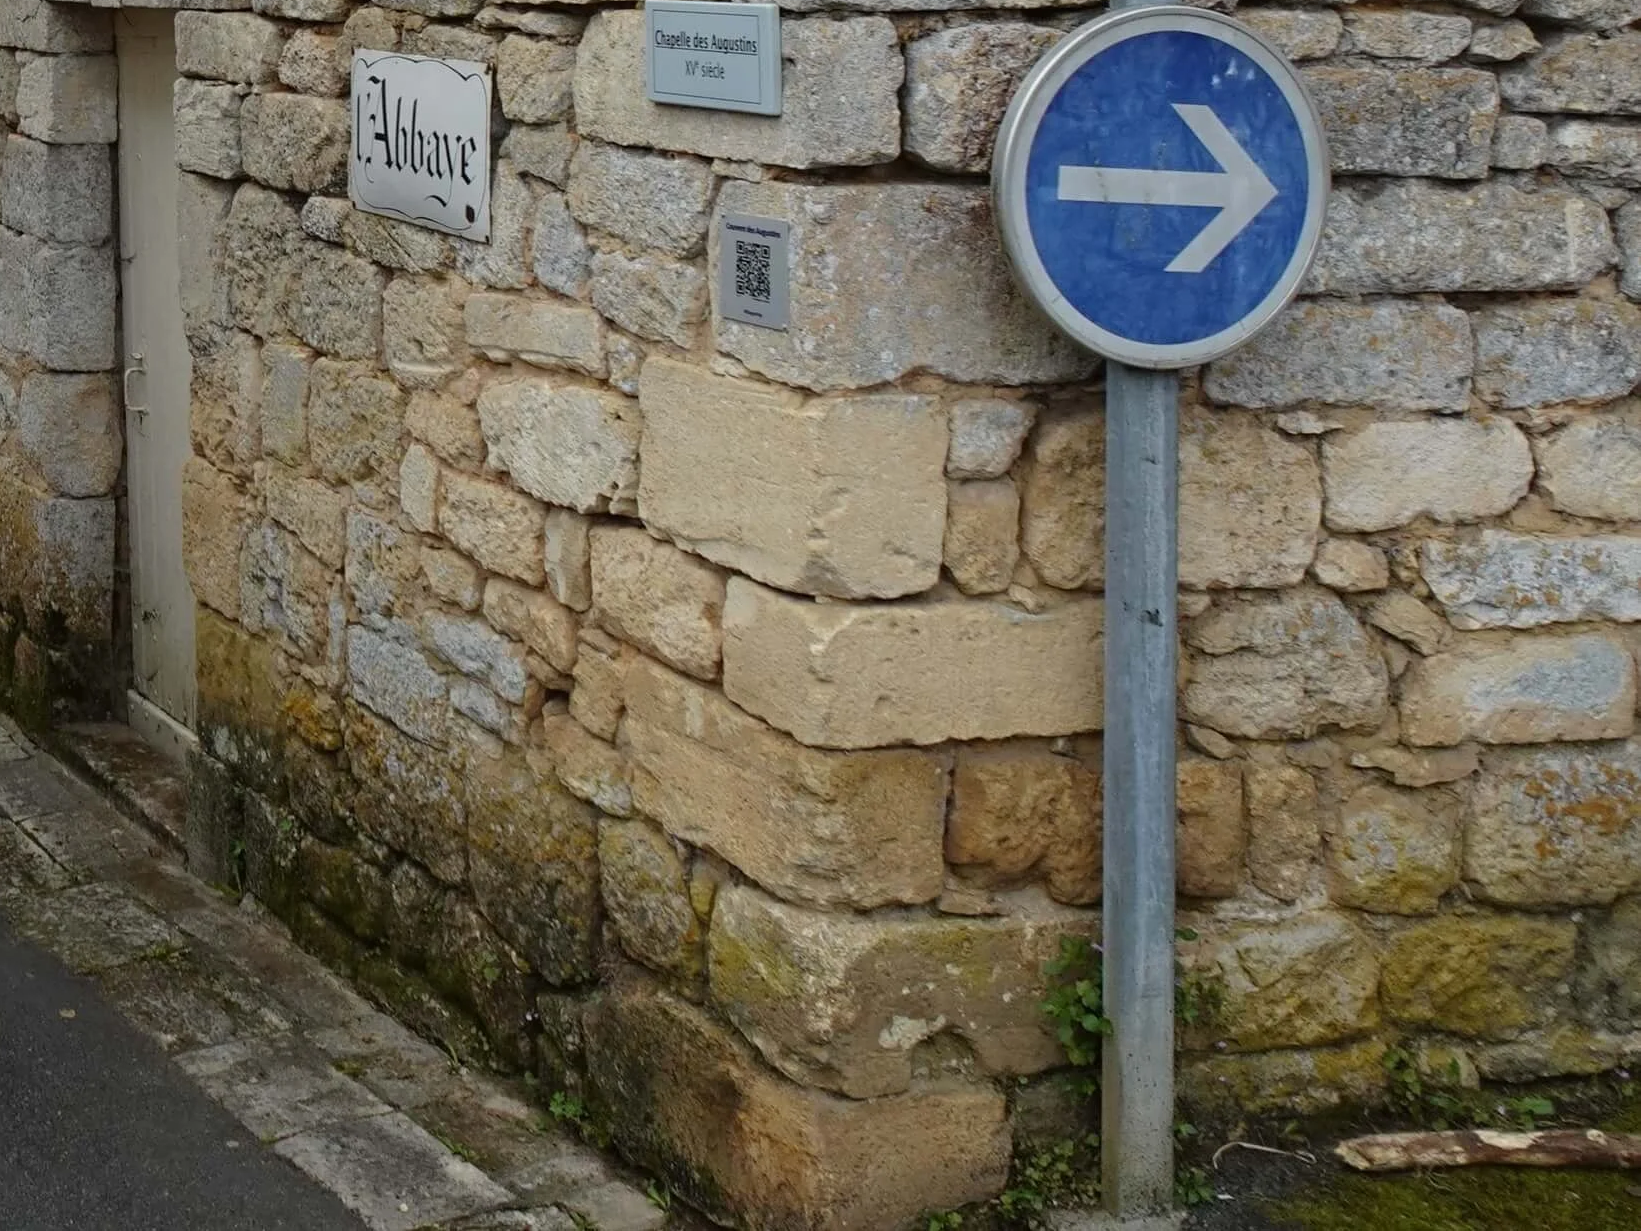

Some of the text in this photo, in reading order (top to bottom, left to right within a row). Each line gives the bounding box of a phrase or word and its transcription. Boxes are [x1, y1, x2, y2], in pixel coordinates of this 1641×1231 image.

[655, 30, 758, 54] Chapelle des Augustins
[701, 63, 725, 80] siècle
[356, 75, 477, 208] l'Abbaye
